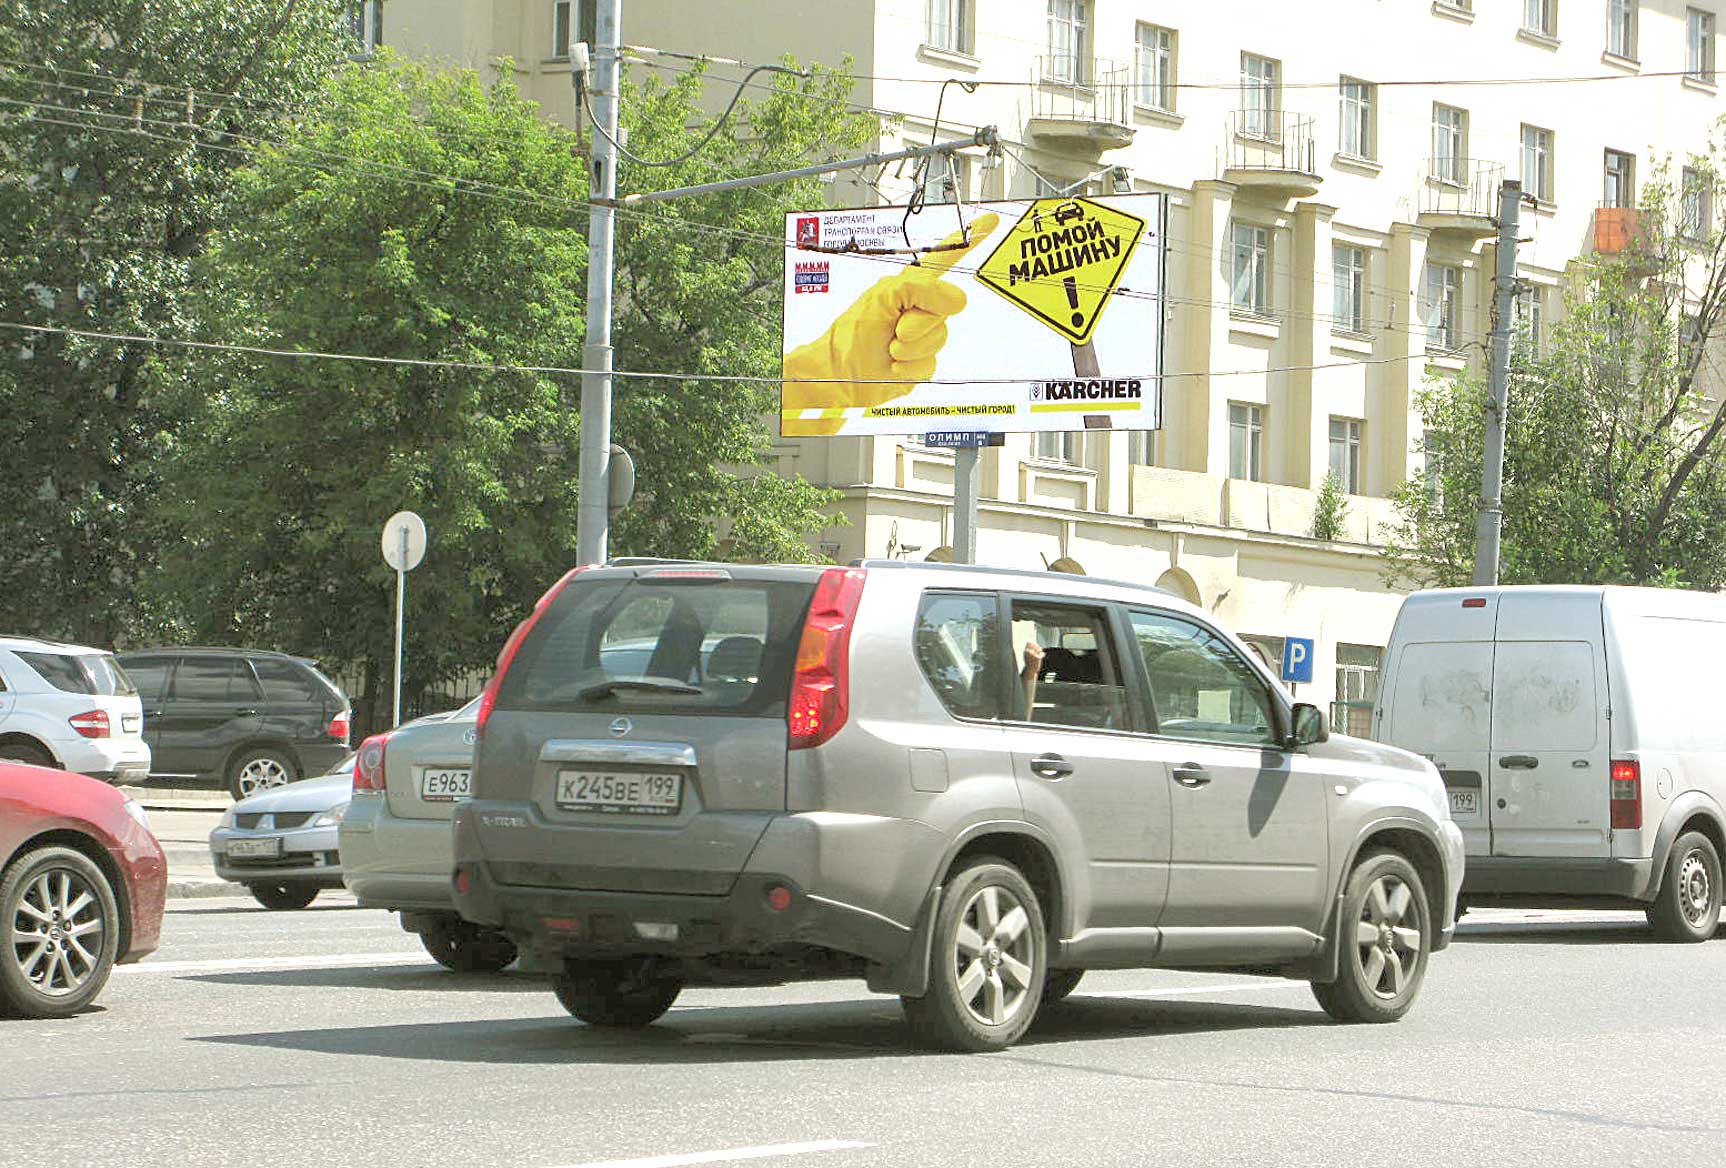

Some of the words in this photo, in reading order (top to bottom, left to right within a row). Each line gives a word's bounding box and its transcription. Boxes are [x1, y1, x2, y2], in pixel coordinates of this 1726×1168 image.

[1021, 216, 1105, 259] ПОМОЙ
[1009, 235, 1121, 287] МАШИНУ
[871, 406, 900, 416] ЧИСТЫЙ
[902, 405, 950, 416] АВТОМОБИЛЬ
[957, 404, 987, 415] ЧИСТЫЙ
[988, 404, 1015, 415] ГОРОД!
[929, 432, 970, 442] ОЛИМП
[1289, 643, 1306, 674] P
[645, 776, 674, 796] 199
[1453, 793, 1473, 808] 199
